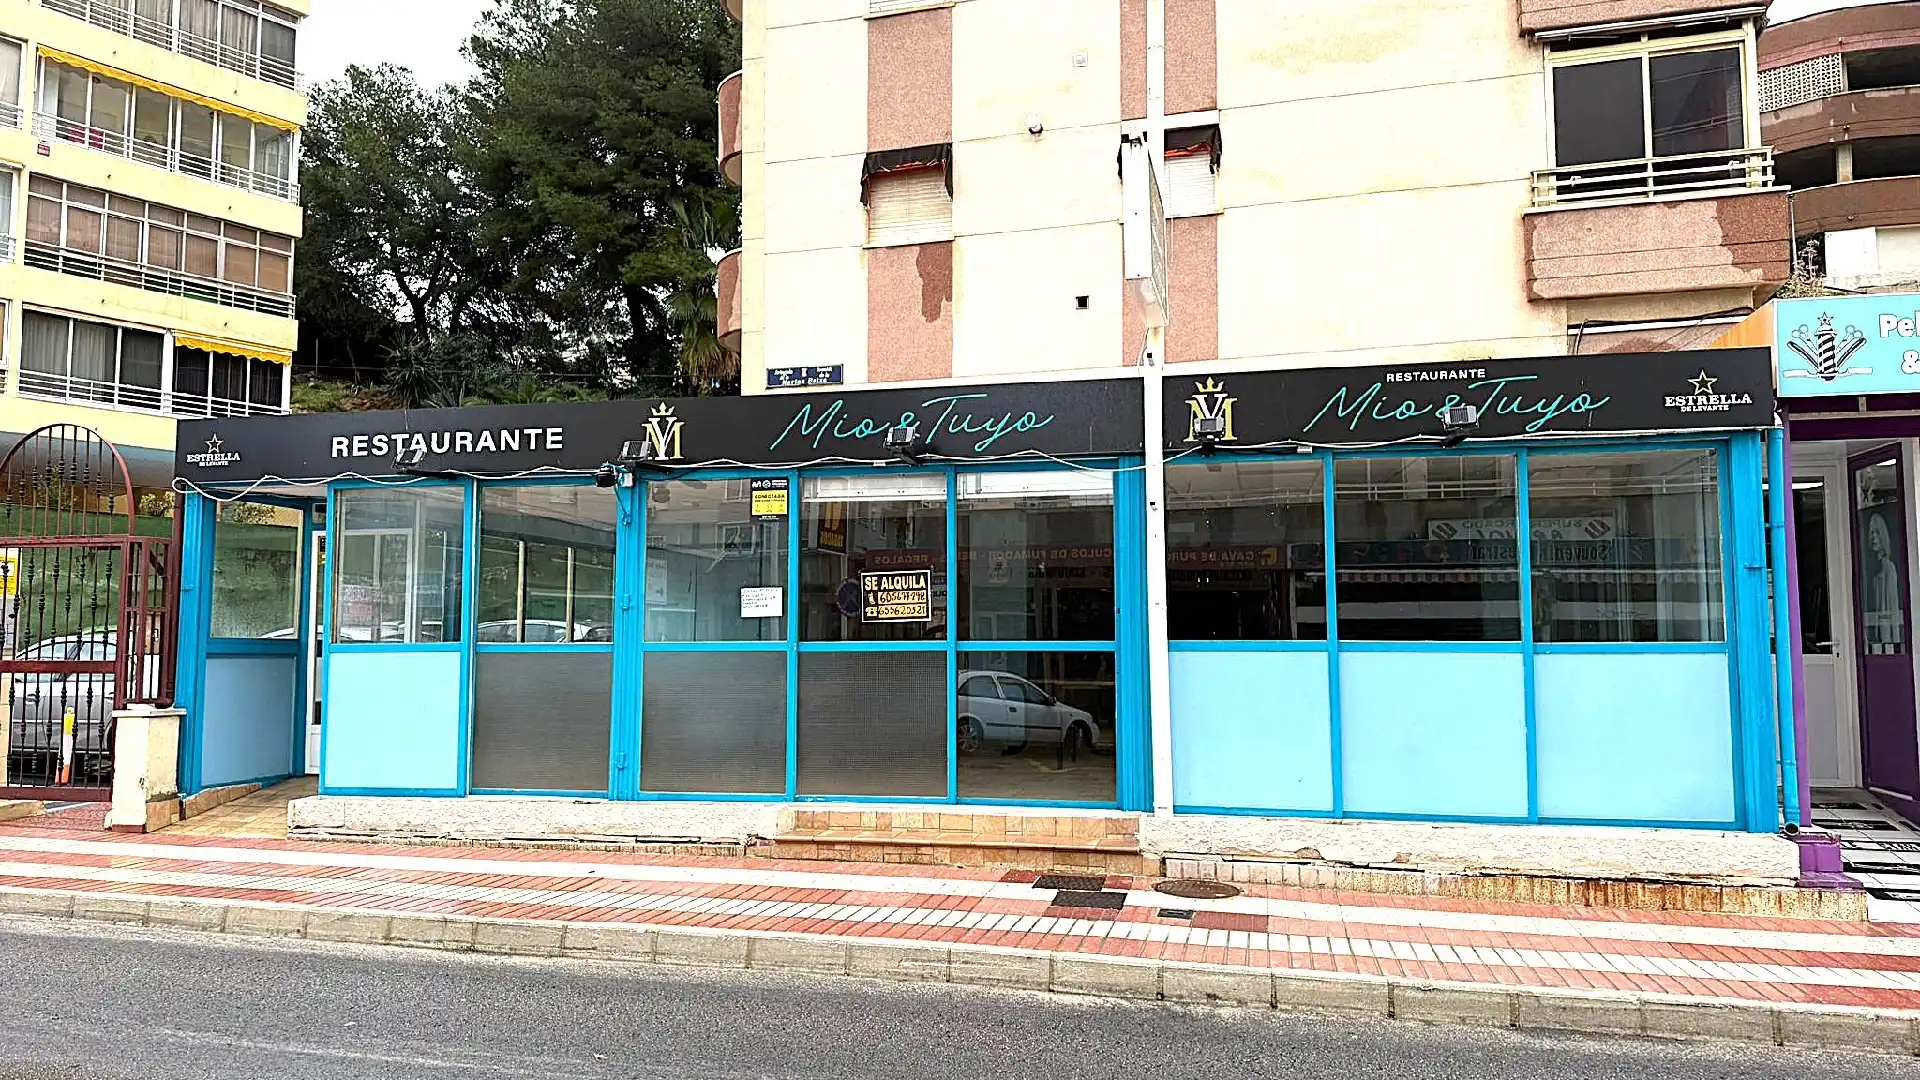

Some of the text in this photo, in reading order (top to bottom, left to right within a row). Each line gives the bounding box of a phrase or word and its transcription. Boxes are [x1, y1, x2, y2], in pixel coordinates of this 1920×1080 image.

[1386, 368, 1486, 383] RESTAURANTE
[1303, 382, 1433, 431] Mio
[1468, 375, 1611, 432] Tuyo
[1664, 393, 1753, 407] ESTRELLA
[1693, 404, 1730, 412] LEVANTE
[770, 399, 892, 451] Mio
[922, 394, 1055, 452] Tuyo
[331, 427, 564, 458] RESTAURANTE
[186, 453, 241, 463] ESTRELLA
[864, 575, 926, 591] SE ALQUILA
